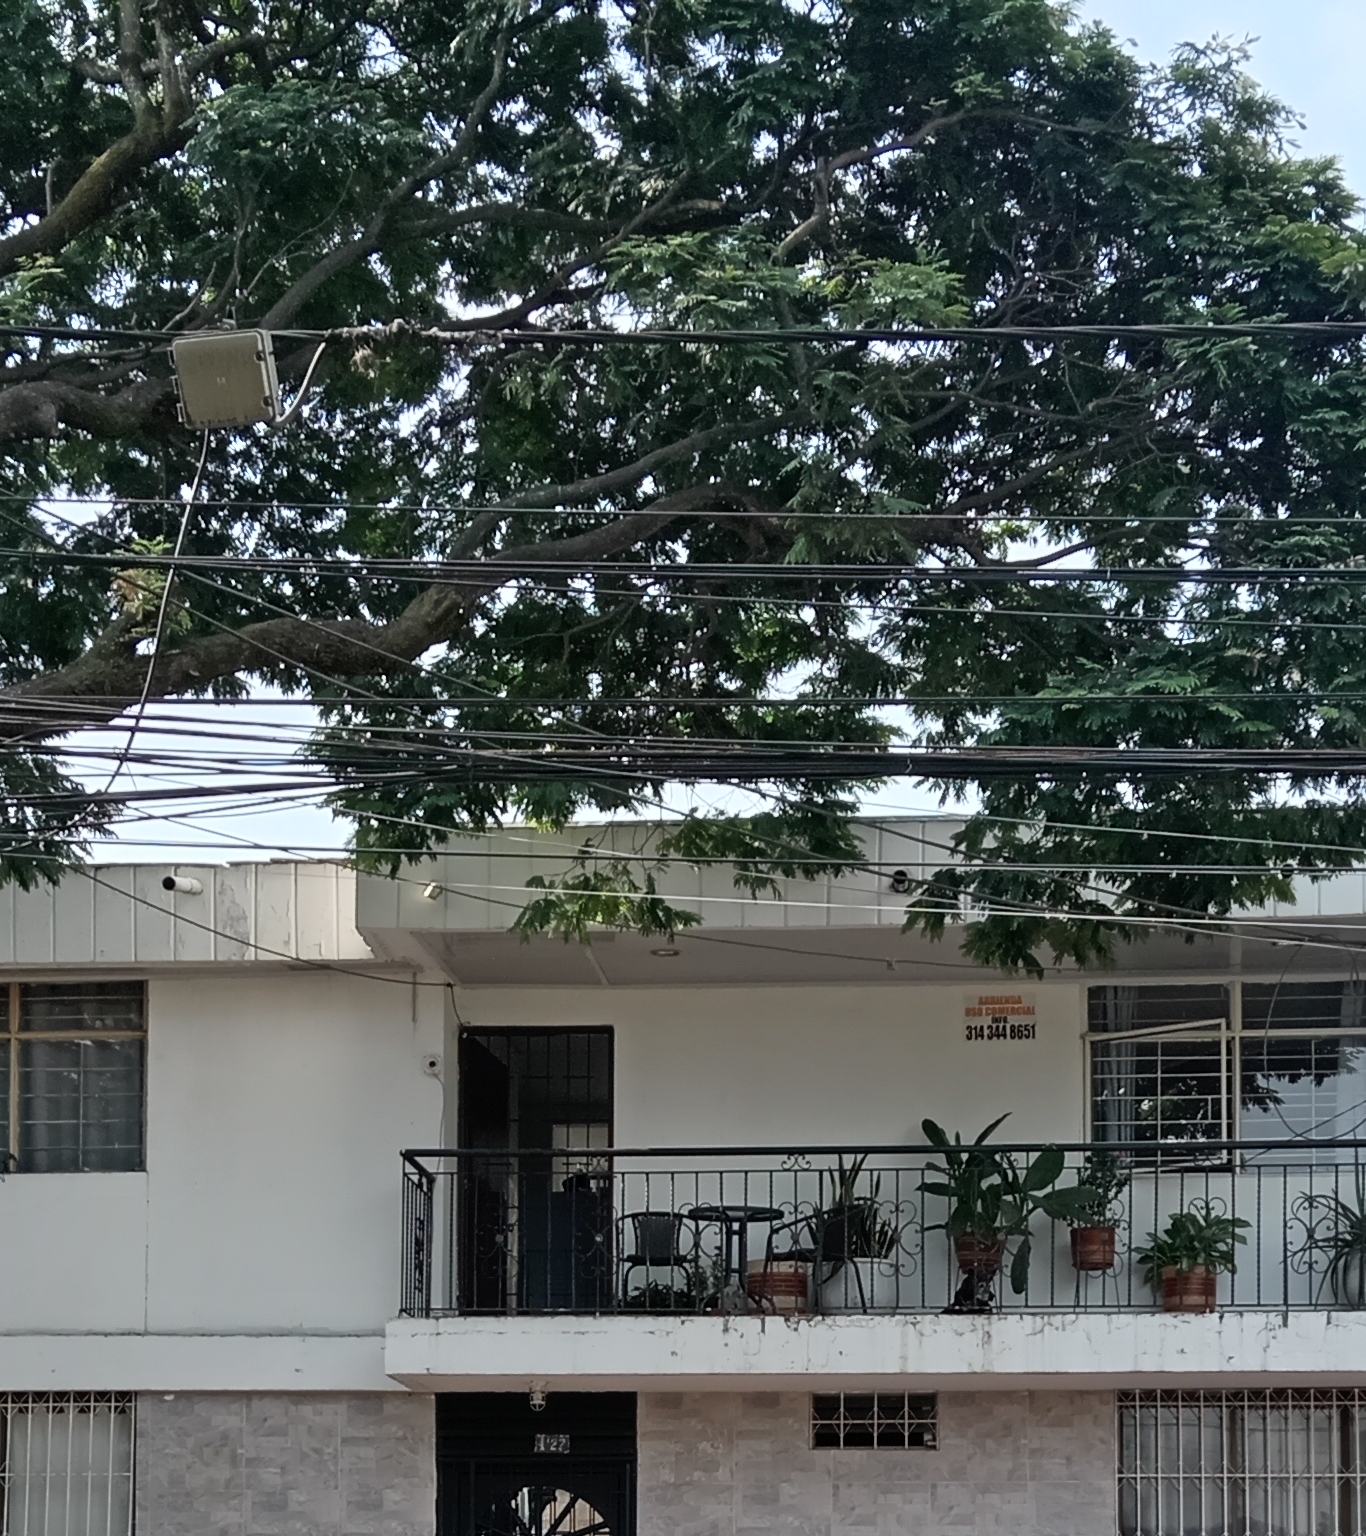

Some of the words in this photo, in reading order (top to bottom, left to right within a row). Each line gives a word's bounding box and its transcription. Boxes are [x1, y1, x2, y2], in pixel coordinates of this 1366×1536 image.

[978, 995, 1022, 1005] ARRIENDA
[965, 1007, 983, 1017] USO
[985, 1006, 1035, 1016] COMERCIAL
[965, 1025, 984, 1041] 314
[986, 1024, 1007, 1040] 344
[1010, 1024, 1036, 1040] 8651
